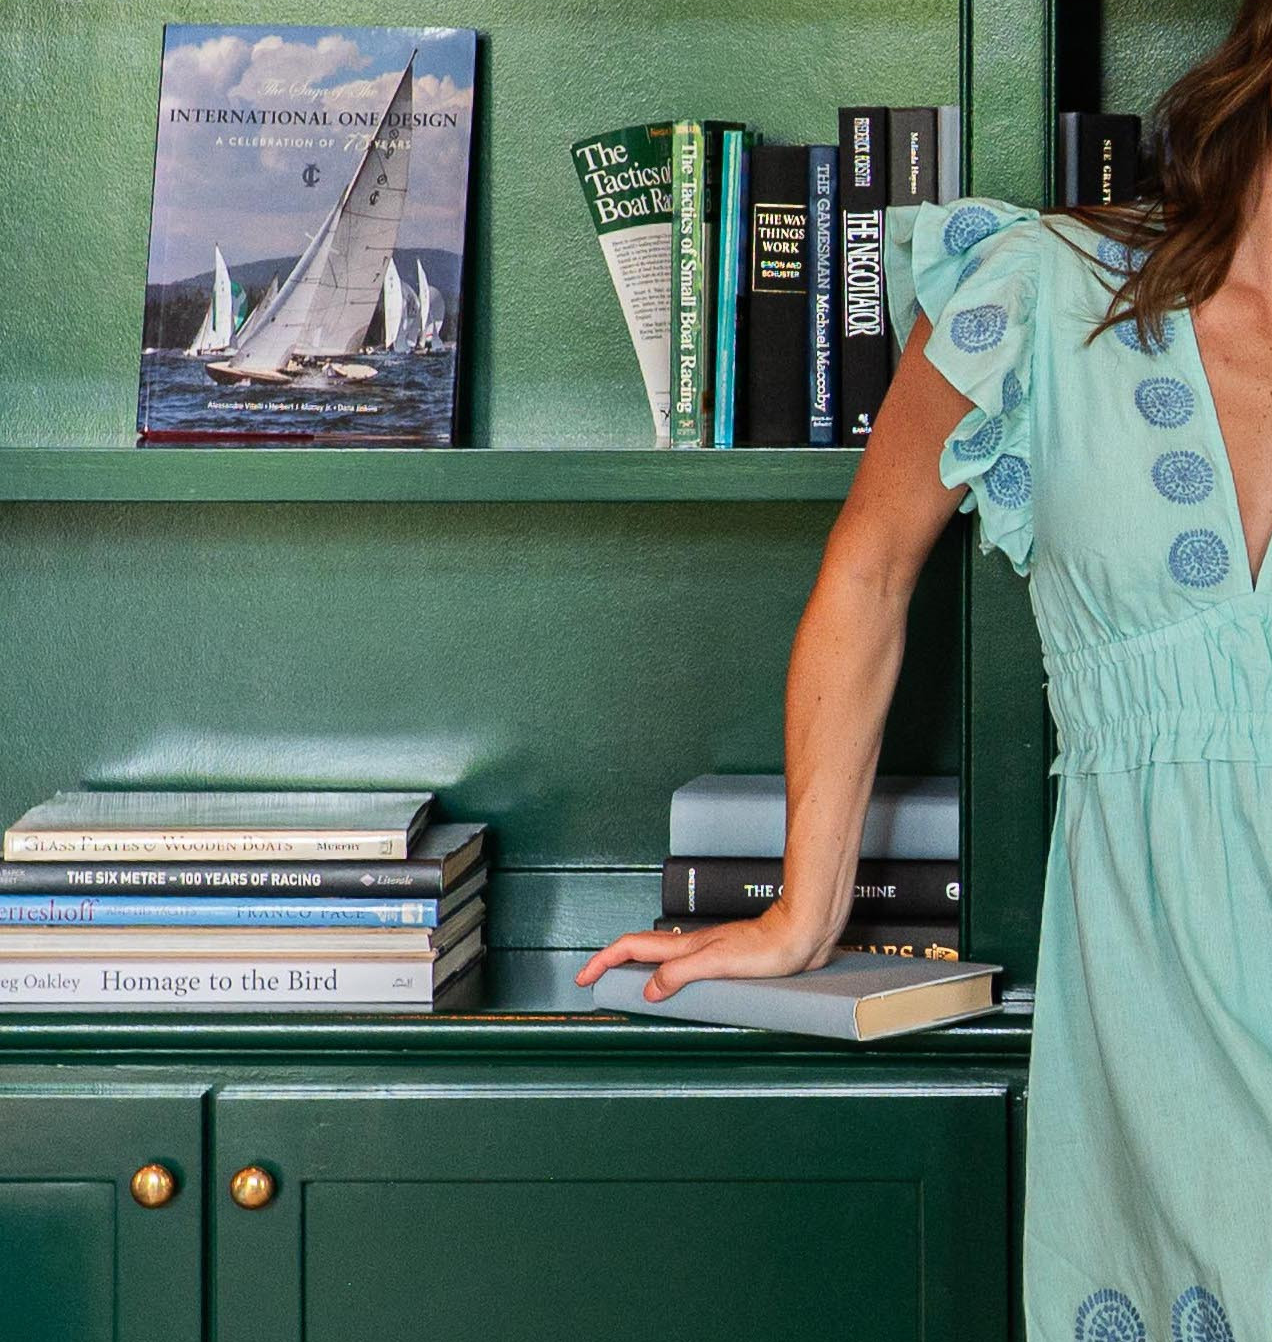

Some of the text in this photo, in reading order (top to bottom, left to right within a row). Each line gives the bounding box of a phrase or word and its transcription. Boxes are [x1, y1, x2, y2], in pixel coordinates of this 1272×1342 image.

[169, 108, 459, 129] INTERNATIONAL ONE DESIGN
[215, 137, 223, 146] A
[228, 136, 313, 148] CELEBRATION
[319, 138, 335, 148] OF
[374, 137, 412, 149] YEARS
[576, 142, 629, 172] The
[681, 142, 697, 178] The
[1102, 139, 1112, 206] SUE GRAFT
[584, 162, 659, 198] Tactics
[816, 163, 830, 194] THE
[594, 187, 673, 225] Boat Rac
[681, 180, 697, 236] Tactics
[757, 214, 806, 226] THE WAY
[681, 238, 696, 259] of
[758, 226, 805, 241] THINGS
[762, 240, 799, 254] WORK
[816, 198, 831, 289] GAMESMAN
[681, 260, 696, 307] Small
[845, 210, 881, 337] THE NEGOTIATOR
[680, 311, 696, 353] Boat
[816, 294, 830, 348] Michael
[677, 355, 694, 413] Racing
[814, 350, 831, 413] Maccoby
[24, 836, 77, 853] GLASS
[80, 836, 141, 853] PLATES
[162, 836, 237, 853] WOODEN
[242, 836, 294, 853] BOATS
[66, 871, 321, 888] THE SIX METRE 100 YEARS OF RACING
[744, 884, 774, 899] THE
[854, 885, 896, 899] CHINE
[0, 898, 99, 923] erreshoff
[23, 972, 81, 995] Oakley
[101, 970, 201, 997] Homage
[209, 974, 233, 993] to
[241, 970, 280, 993] the
[287, 969, 338, 993] Bird
